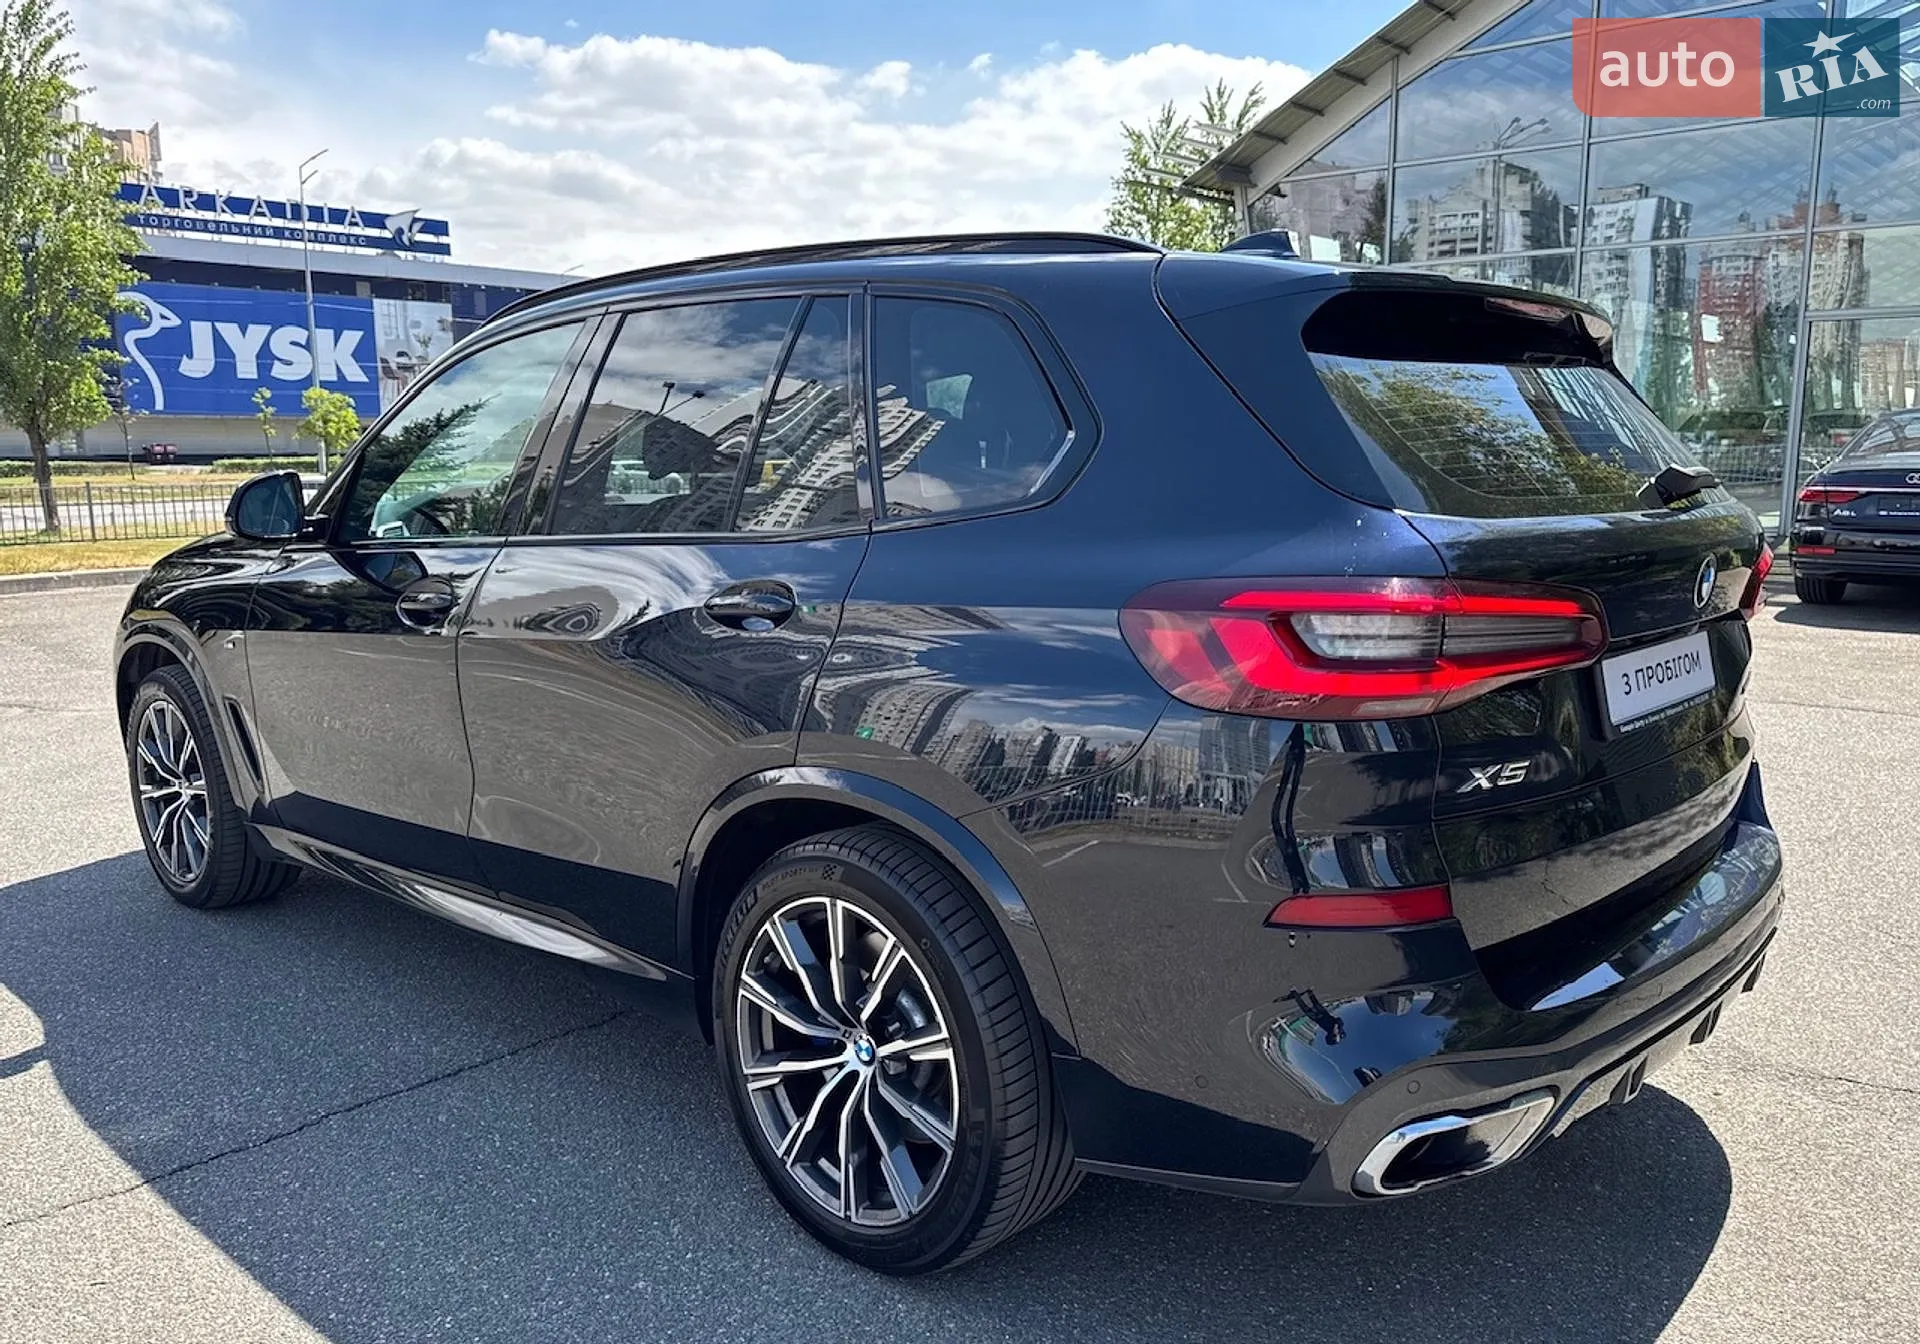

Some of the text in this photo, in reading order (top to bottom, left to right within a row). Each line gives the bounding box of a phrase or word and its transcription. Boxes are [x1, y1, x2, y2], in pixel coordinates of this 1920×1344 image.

[138, 214, 366, 245] торговельний комплекс
[139, 183, 364, 230] ARKADIA
[178, 320, 369, 382] JYSK
[1621, 650, 1702, 696] З ПРОБІГОМ
[1456, 759, 1531, 793] X5
